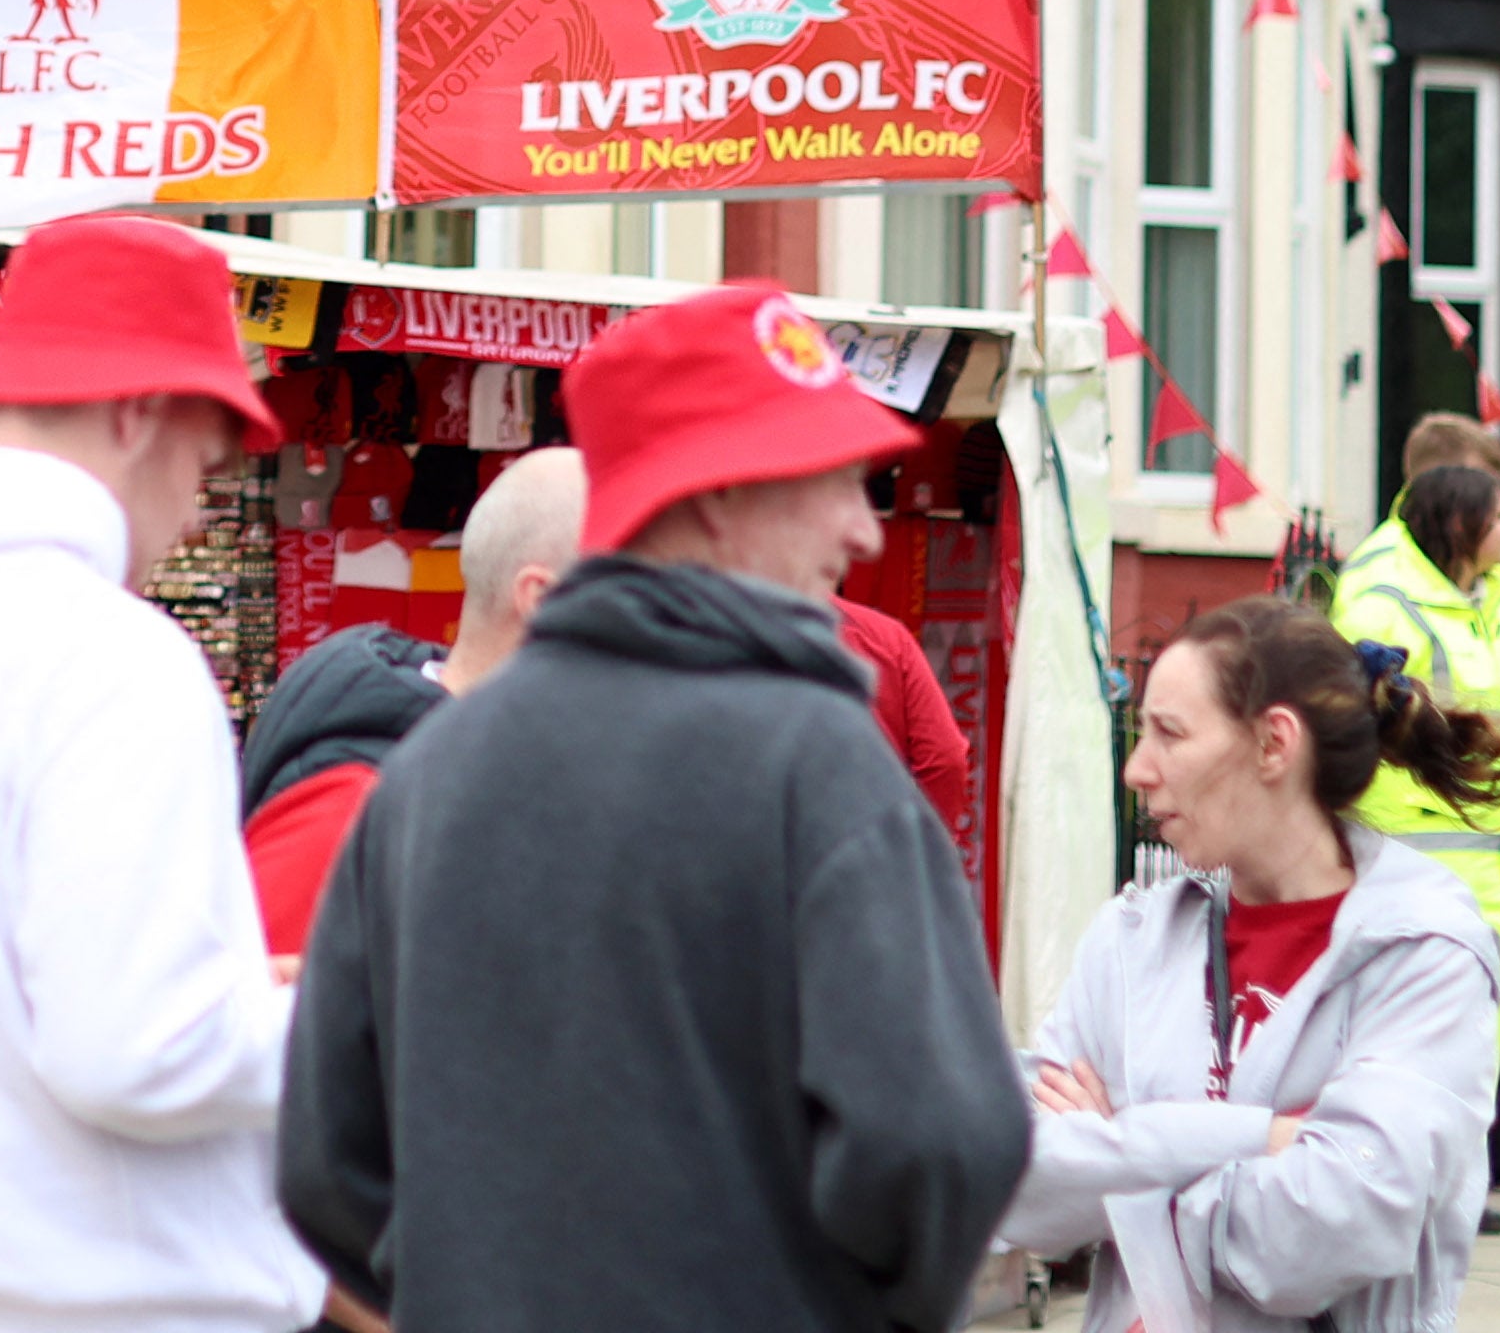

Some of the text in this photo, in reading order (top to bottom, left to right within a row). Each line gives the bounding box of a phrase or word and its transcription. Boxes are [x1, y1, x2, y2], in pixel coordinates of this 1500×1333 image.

[410, 2, 539, 130] FOOTBALL
[519, 59, 989, 132] LIVERPOOL FC
[59, 105, 267, 182] REDS
[523, 120, 981, 178] You'll Never Walk Alone
[403, 289, 592, 351] LIVERPOOL
